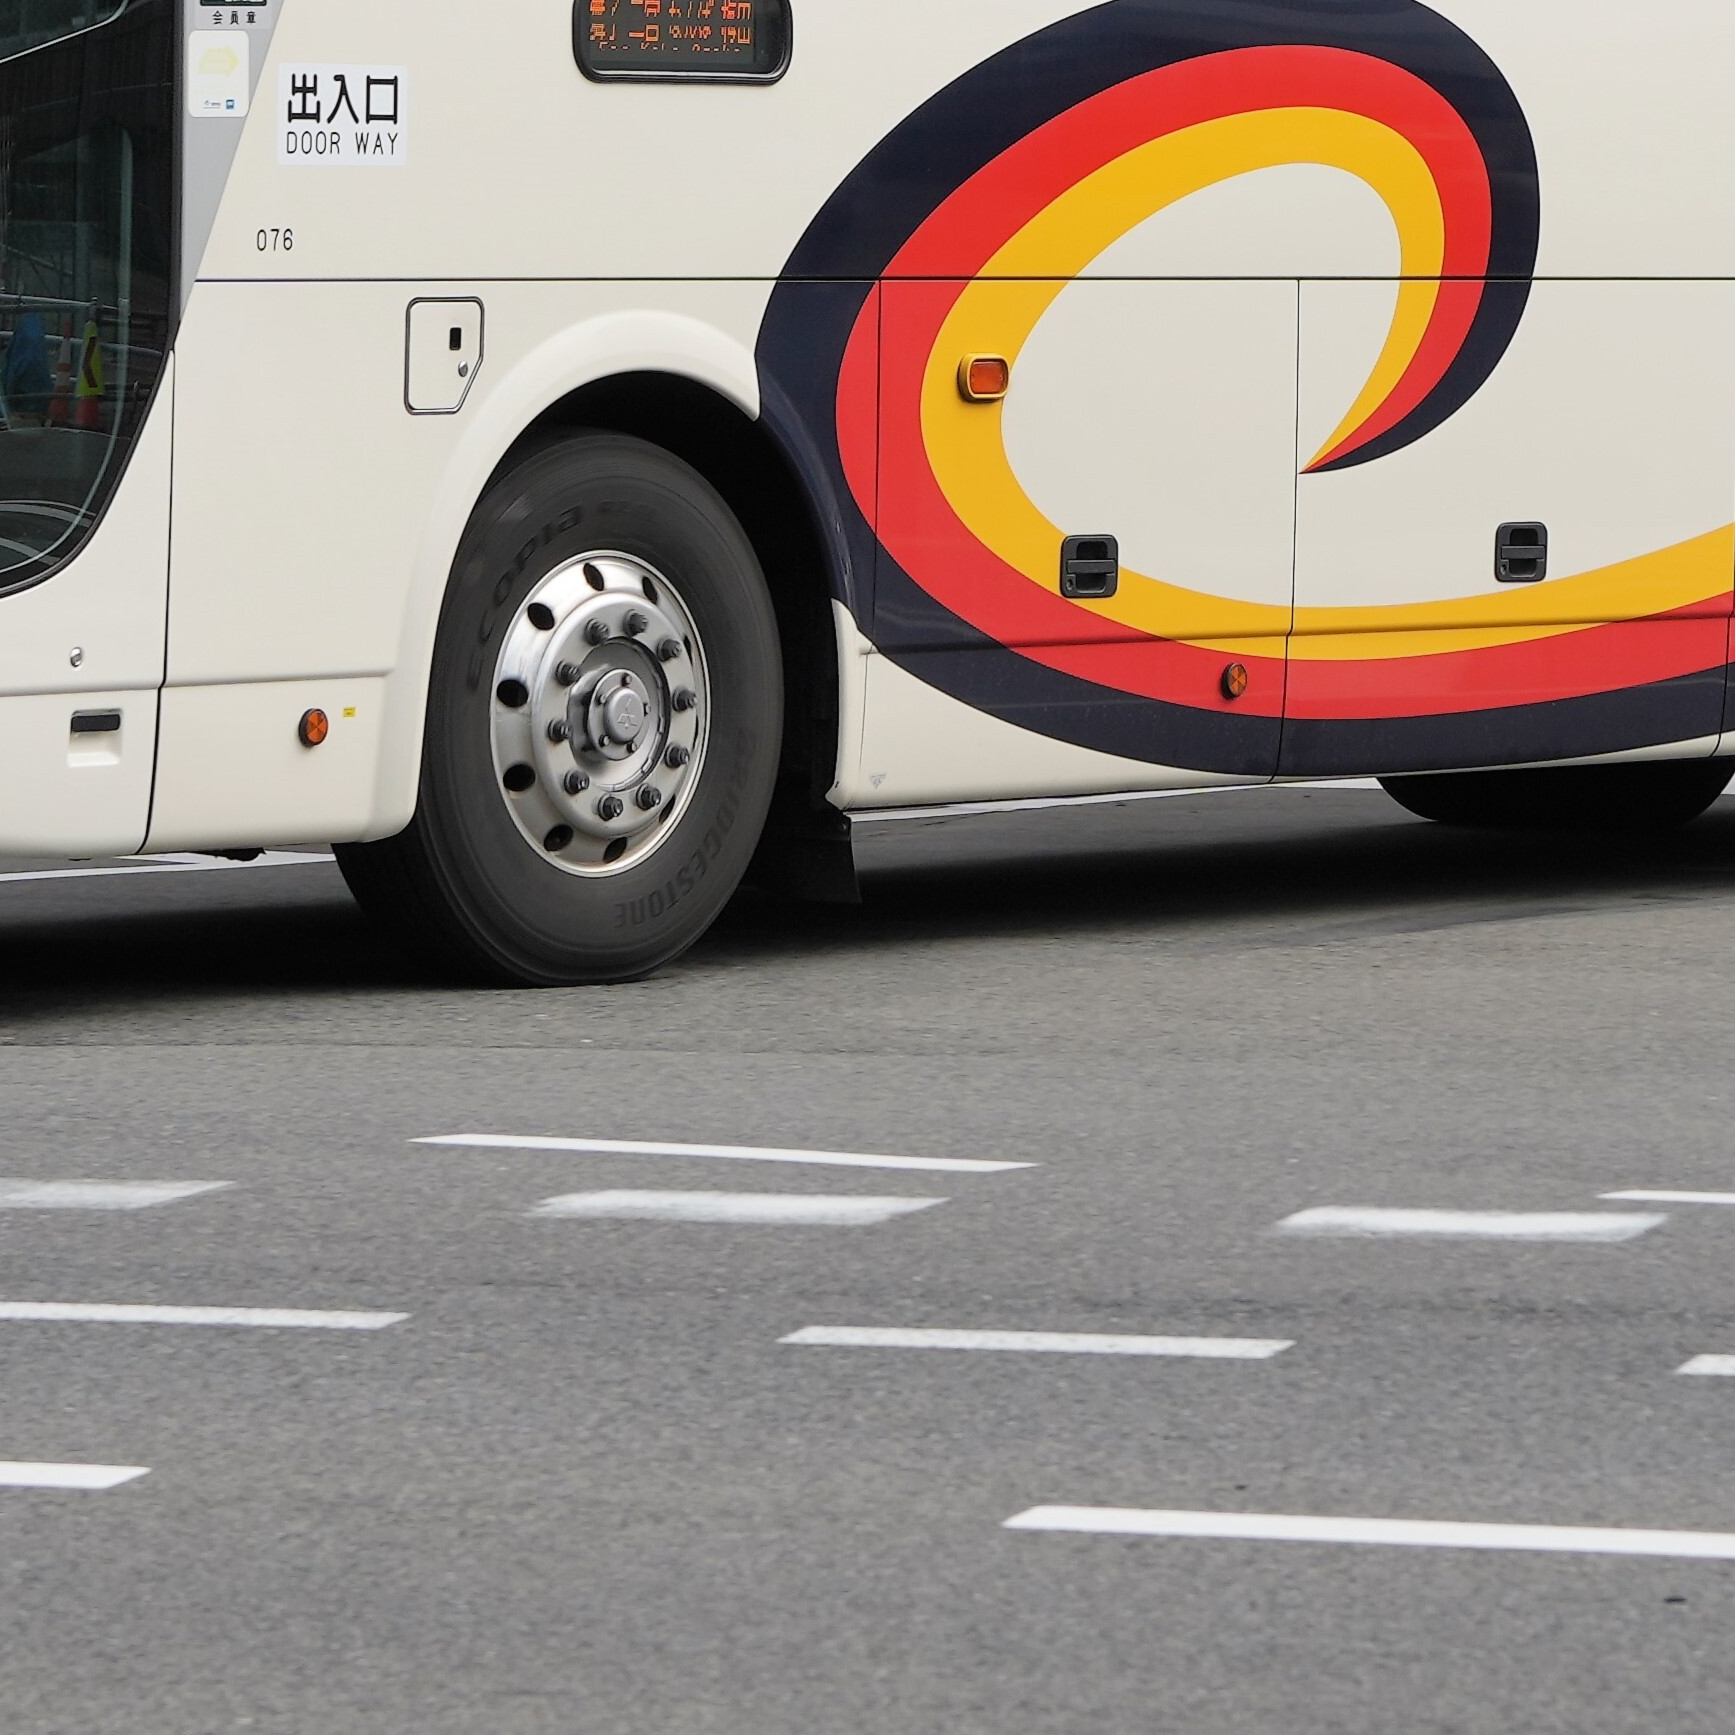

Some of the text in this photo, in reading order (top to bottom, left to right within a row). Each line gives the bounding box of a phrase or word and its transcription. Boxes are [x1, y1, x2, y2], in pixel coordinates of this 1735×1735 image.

[287, 73, 399, 125] 出入口
[286, 130, 399, 155] DOOR WAY
[256, 228, 294, 252] 076
